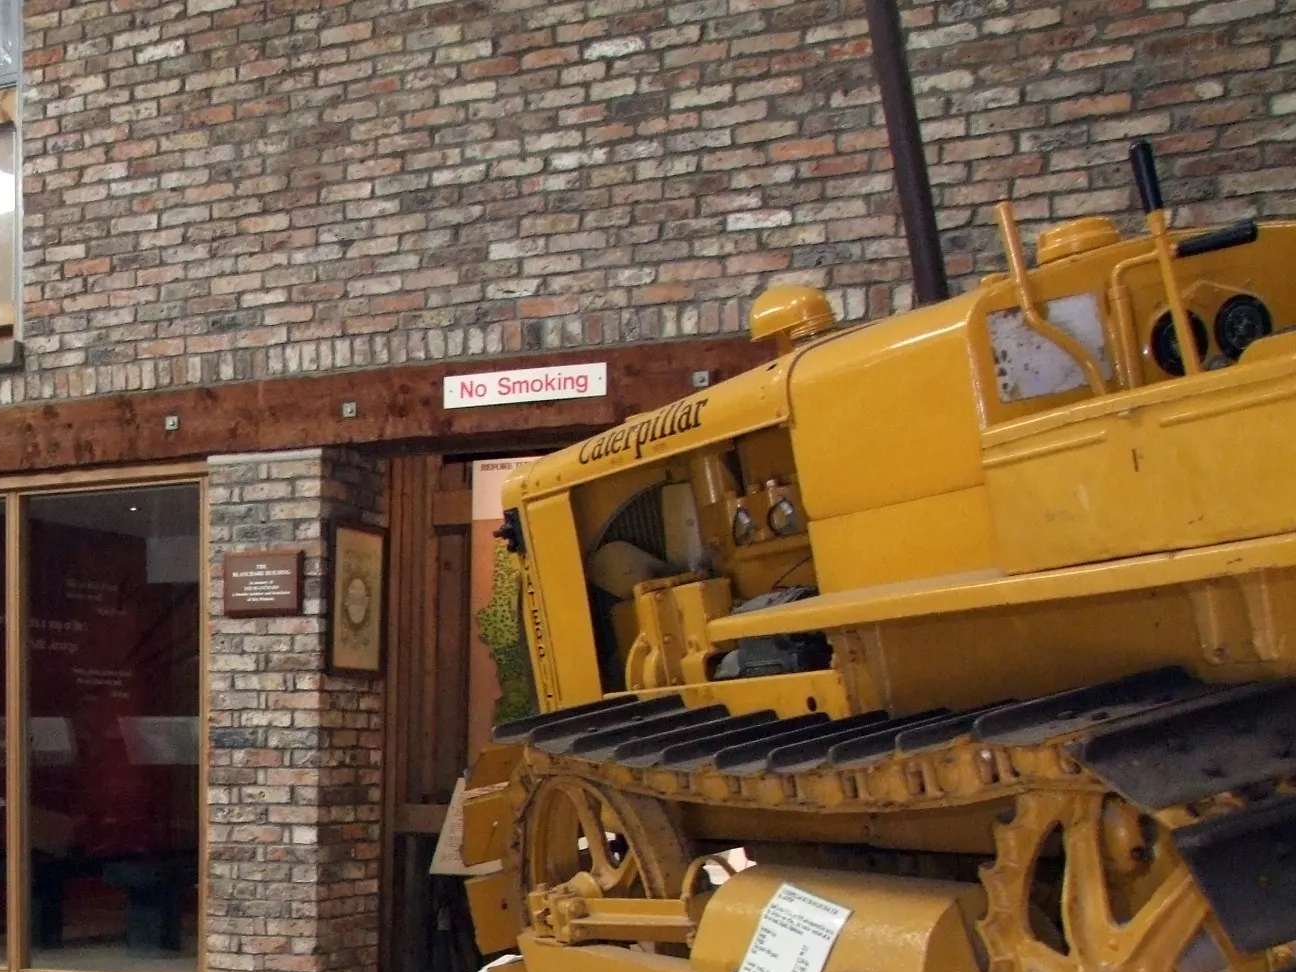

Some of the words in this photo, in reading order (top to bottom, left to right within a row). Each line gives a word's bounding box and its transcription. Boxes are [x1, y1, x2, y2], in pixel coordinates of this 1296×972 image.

[460, 381, 487, 399] No
[498, 373, 589, 396] Smoking
[578, 397, 709, 465] Caterpillar
